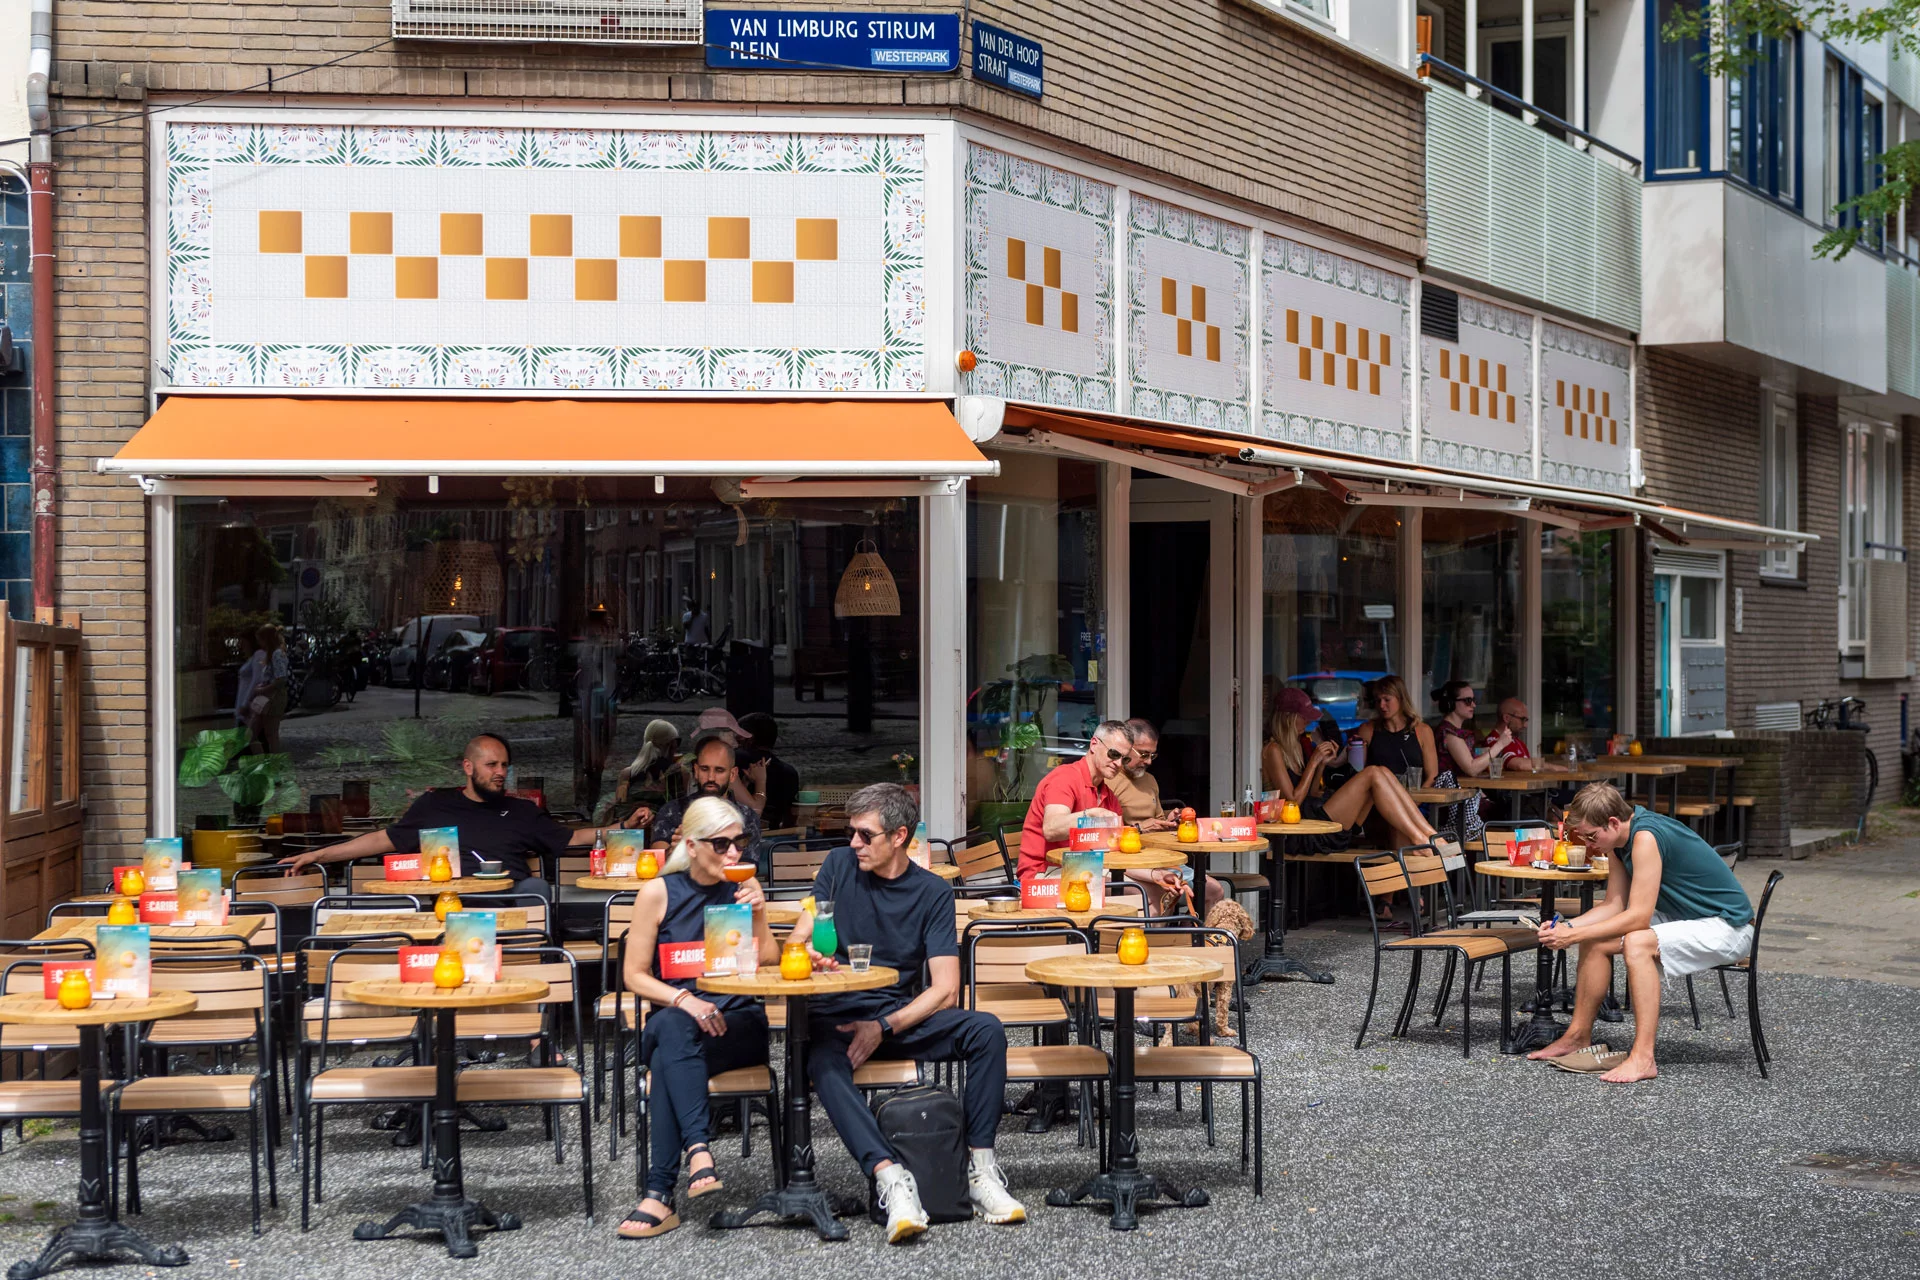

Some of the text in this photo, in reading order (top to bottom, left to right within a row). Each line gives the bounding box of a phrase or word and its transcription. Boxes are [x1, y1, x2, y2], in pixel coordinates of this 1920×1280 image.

[730, 18, 935, 40] VAN LIMBURG STIRUM
[730, 41, 779, 60] PLEIN
[874, 50, 948, 63] WESTERPARK
[979, 29, 1039, 67] VAN DER HOOP
[978, 53, 1007, 79] STRAAT
[1079, 832, 1100, 843] CARIBE
[1031, 884, 1059, 897] CARIBE
[674, 948, 706, 965] CARIBE
